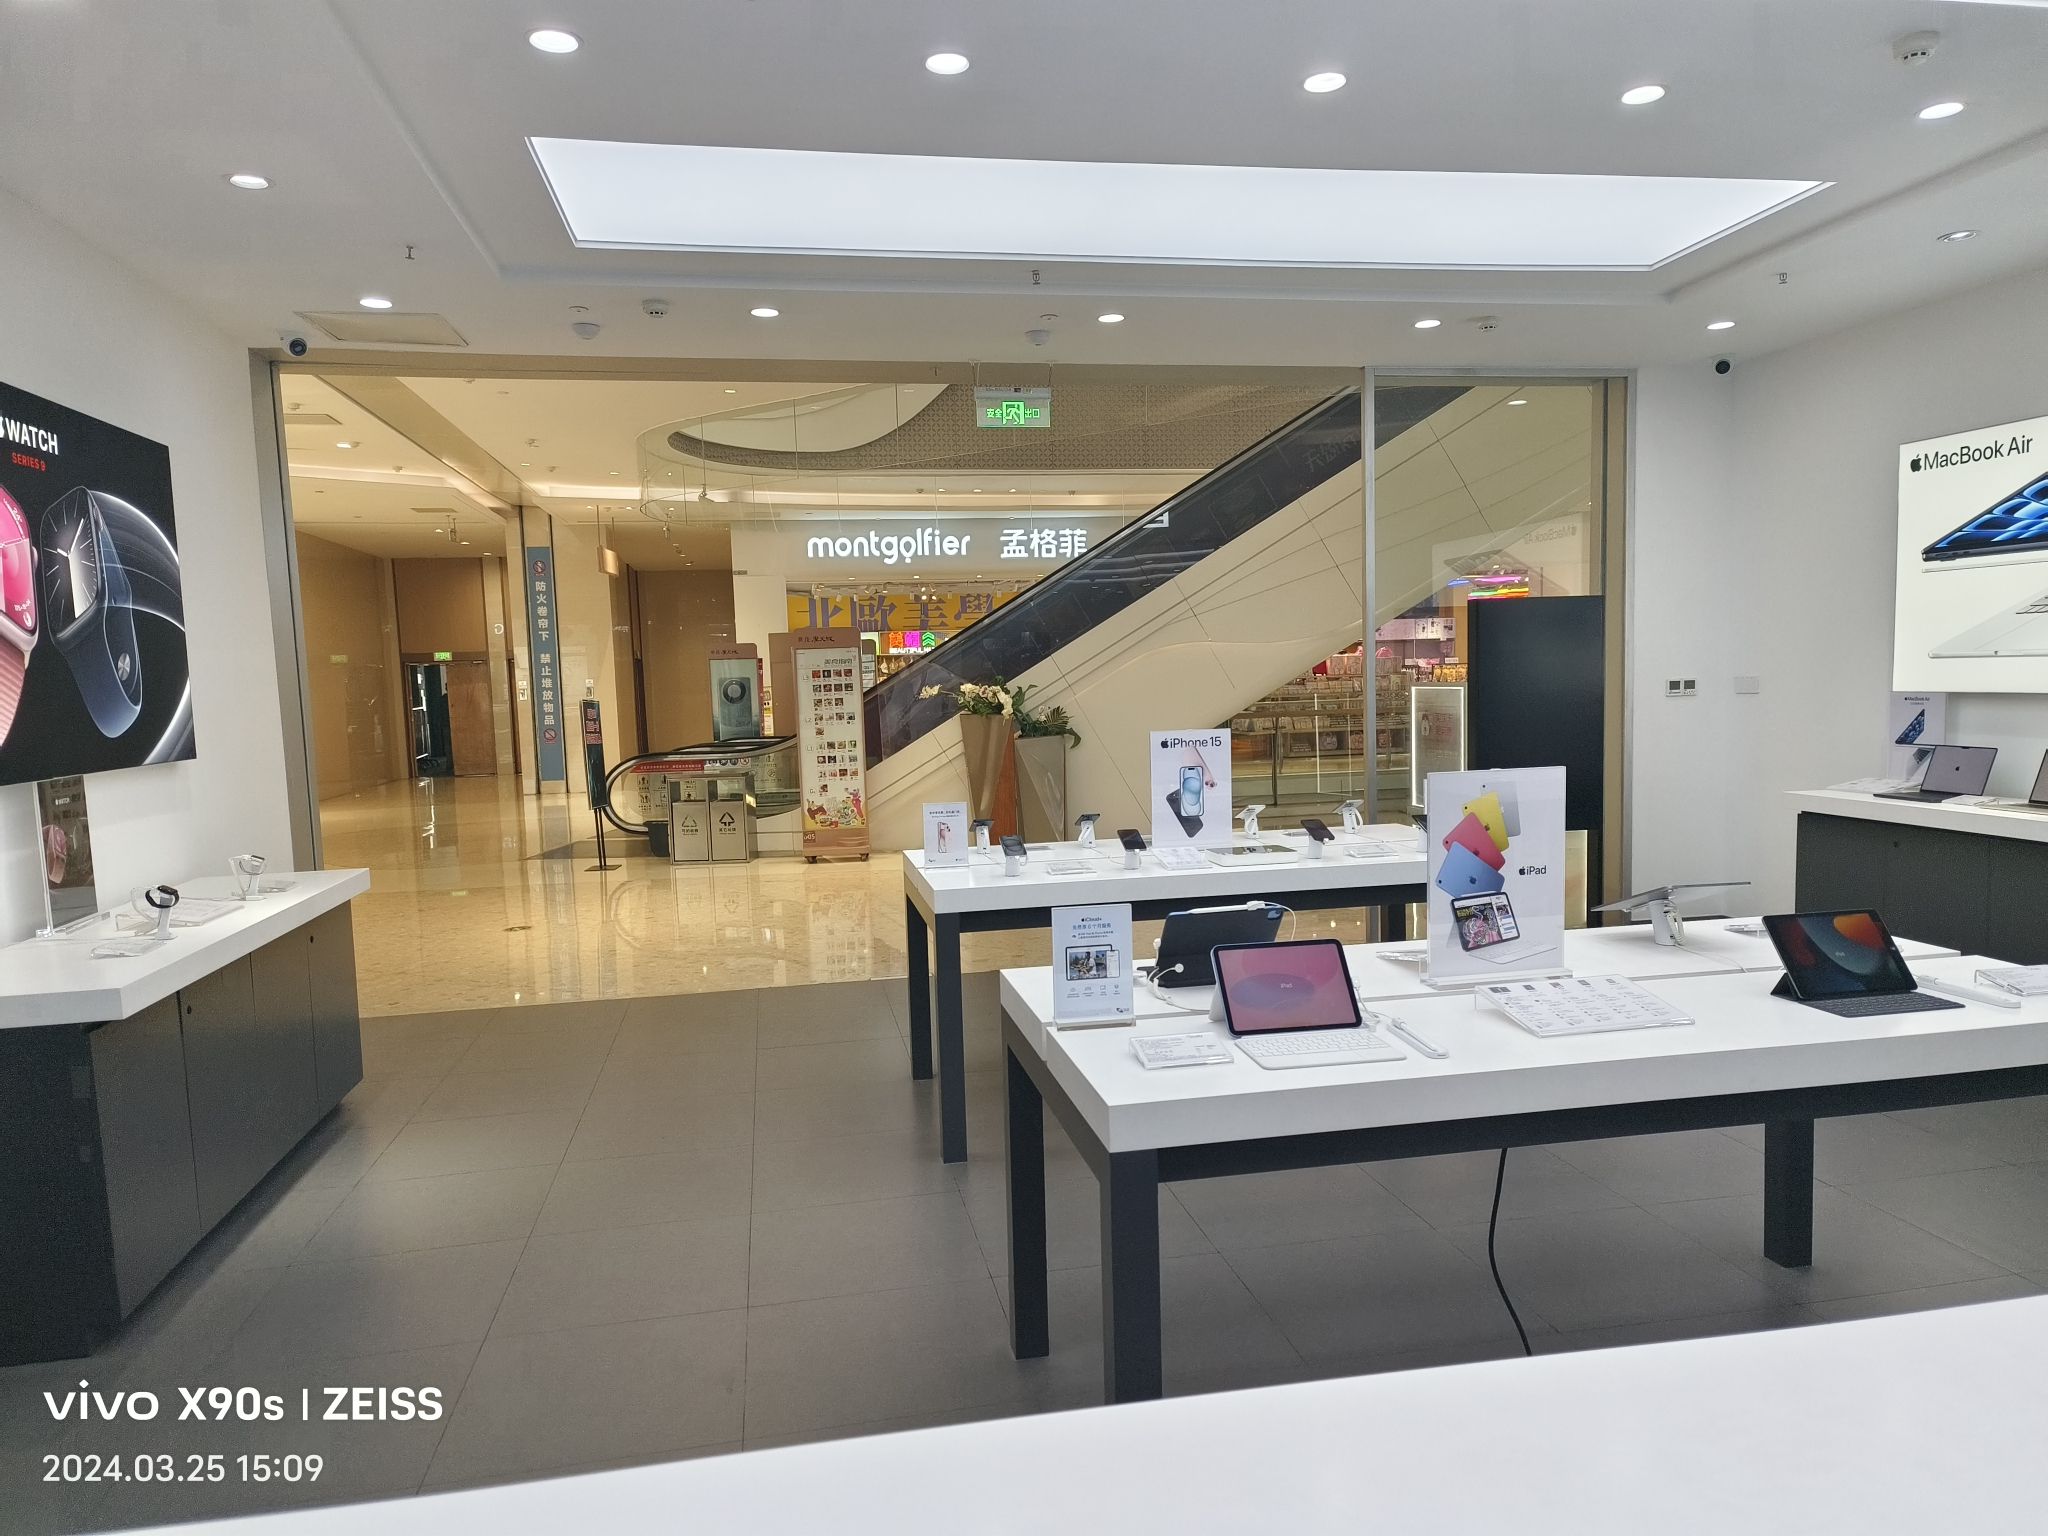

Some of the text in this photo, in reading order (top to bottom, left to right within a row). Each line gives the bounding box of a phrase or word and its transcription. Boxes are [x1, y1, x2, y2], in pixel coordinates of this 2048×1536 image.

[986, 408, 1040, 418] 安全 出口
[5, 417, 58, 455] WATCH
[11, 452, 40, 469] SERIES
[1924, 435, 2034, 471] MacBook Air
[807, 528, 1087, 564] montgolfier 孟格菲
[535, 581, 555, 725] 防火卷帘下 禁止堆放物品
[1170, 736, 1222, 749] iPhone 15
[1526, 865, 1547, 876] iPad
